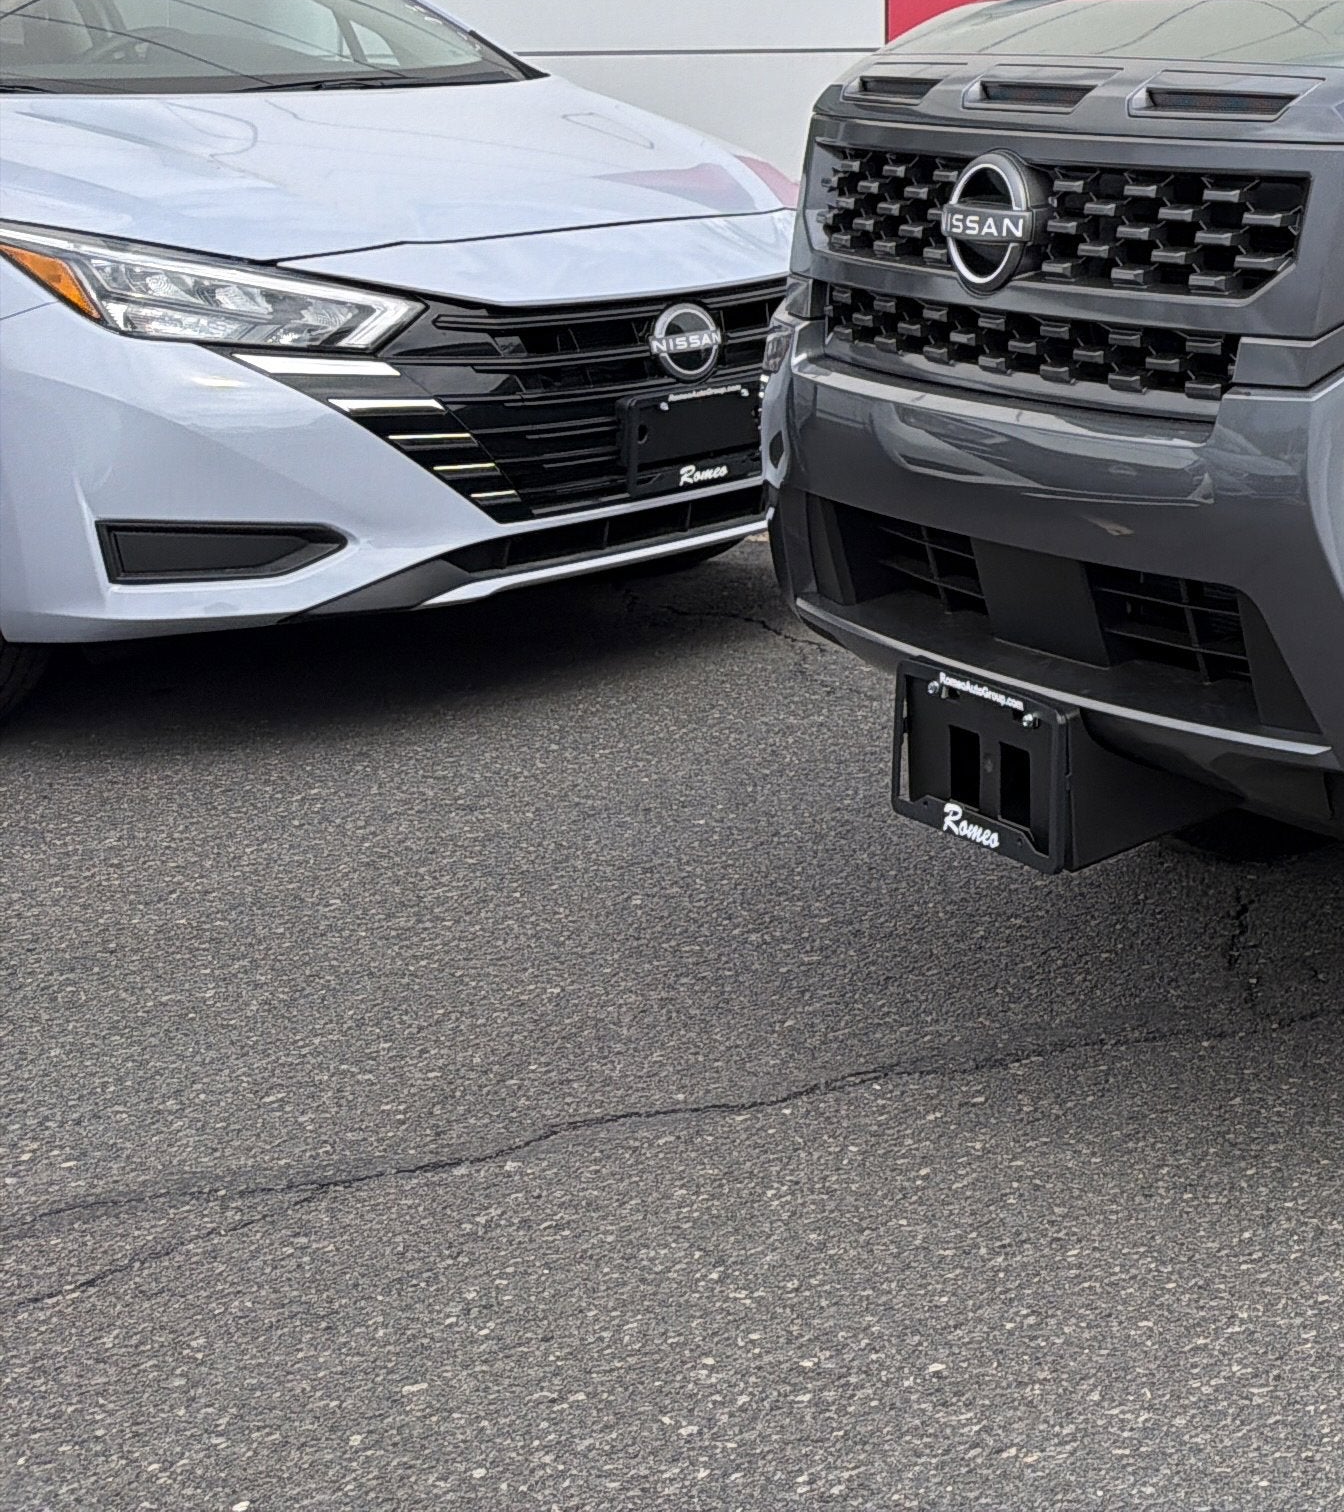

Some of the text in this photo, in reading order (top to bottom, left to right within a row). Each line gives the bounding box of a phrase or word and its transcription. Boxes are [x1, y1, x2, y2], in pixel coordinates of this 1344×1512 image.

[651, 329, 722, 352] NISSAN
[678, 464, 729, 487] Romeo
[939, 671, 1025, 712] RomeoAutoGroup.com
[942, 802, 1000, 849] Romeo
